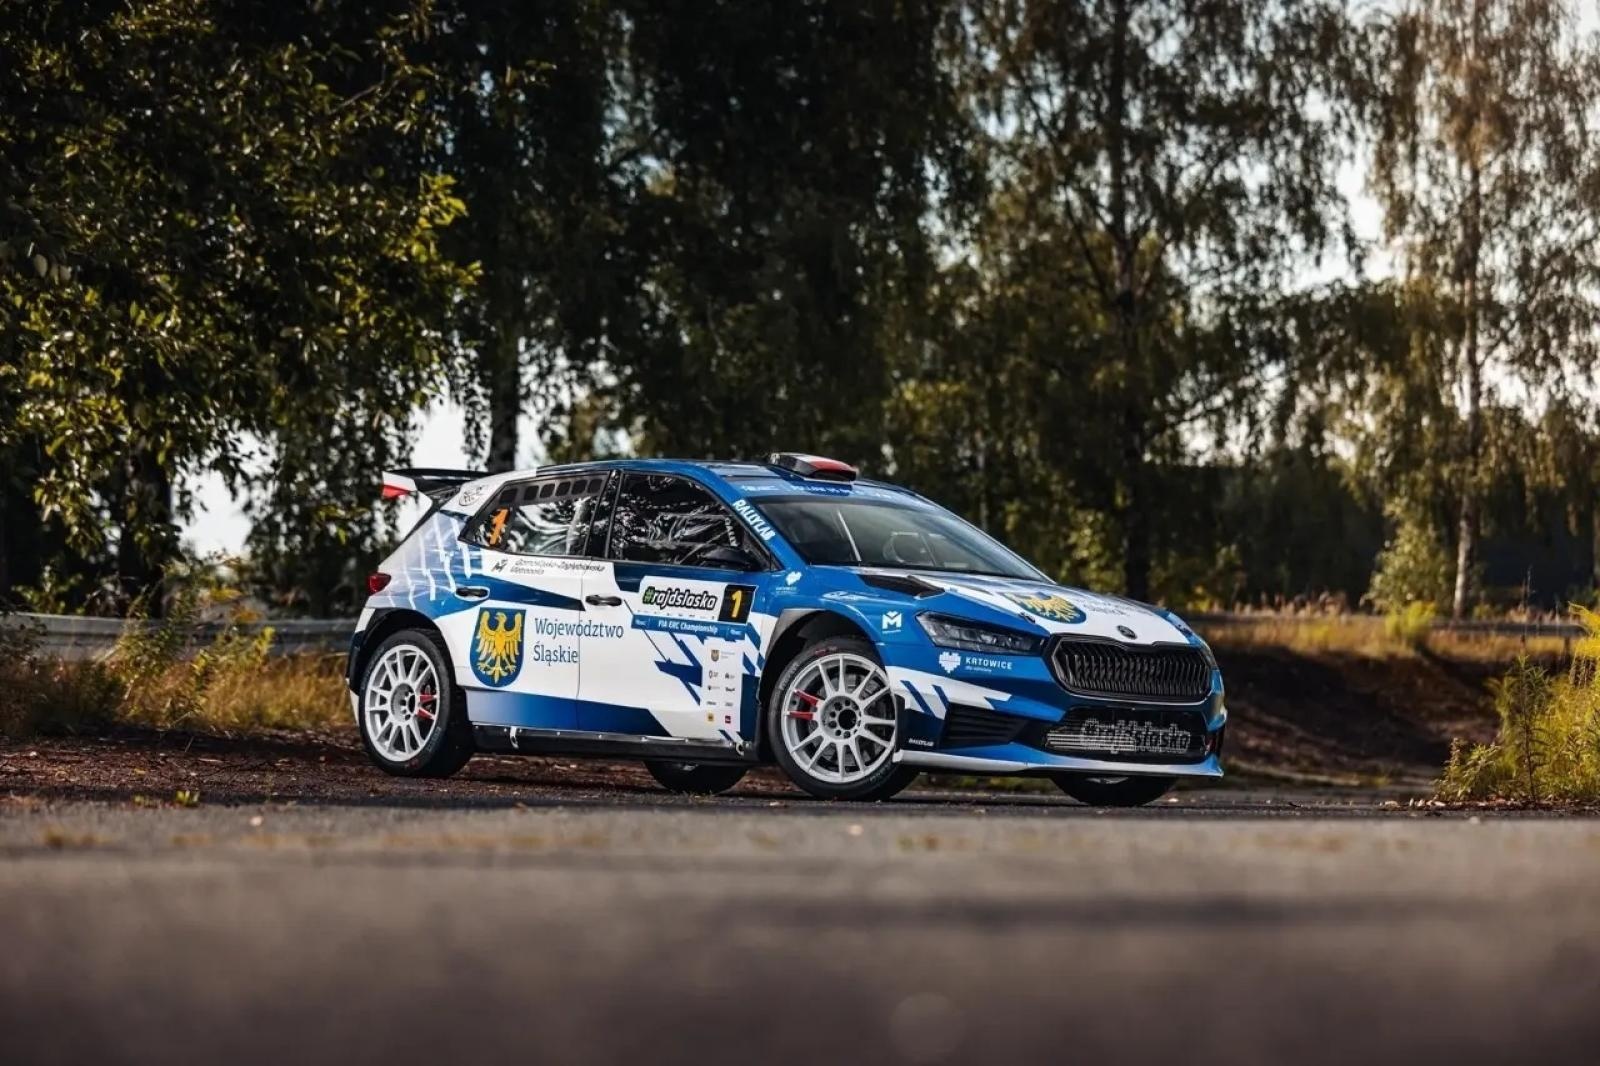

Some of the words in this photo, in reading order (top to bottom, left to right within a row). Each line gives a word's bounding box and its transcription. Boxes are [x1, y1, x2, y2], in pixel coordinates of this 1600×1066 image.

[732, 499, 776, 541] RALLYLAB
[642, 585, 718, 611] #rajdslaska
[731, 589, 743, 618] 1
[534, 617, 624, 640] Województwo
[533, 640, 579, 667] Śląskie
[965, 656, 1013, 670] KATOWICE
